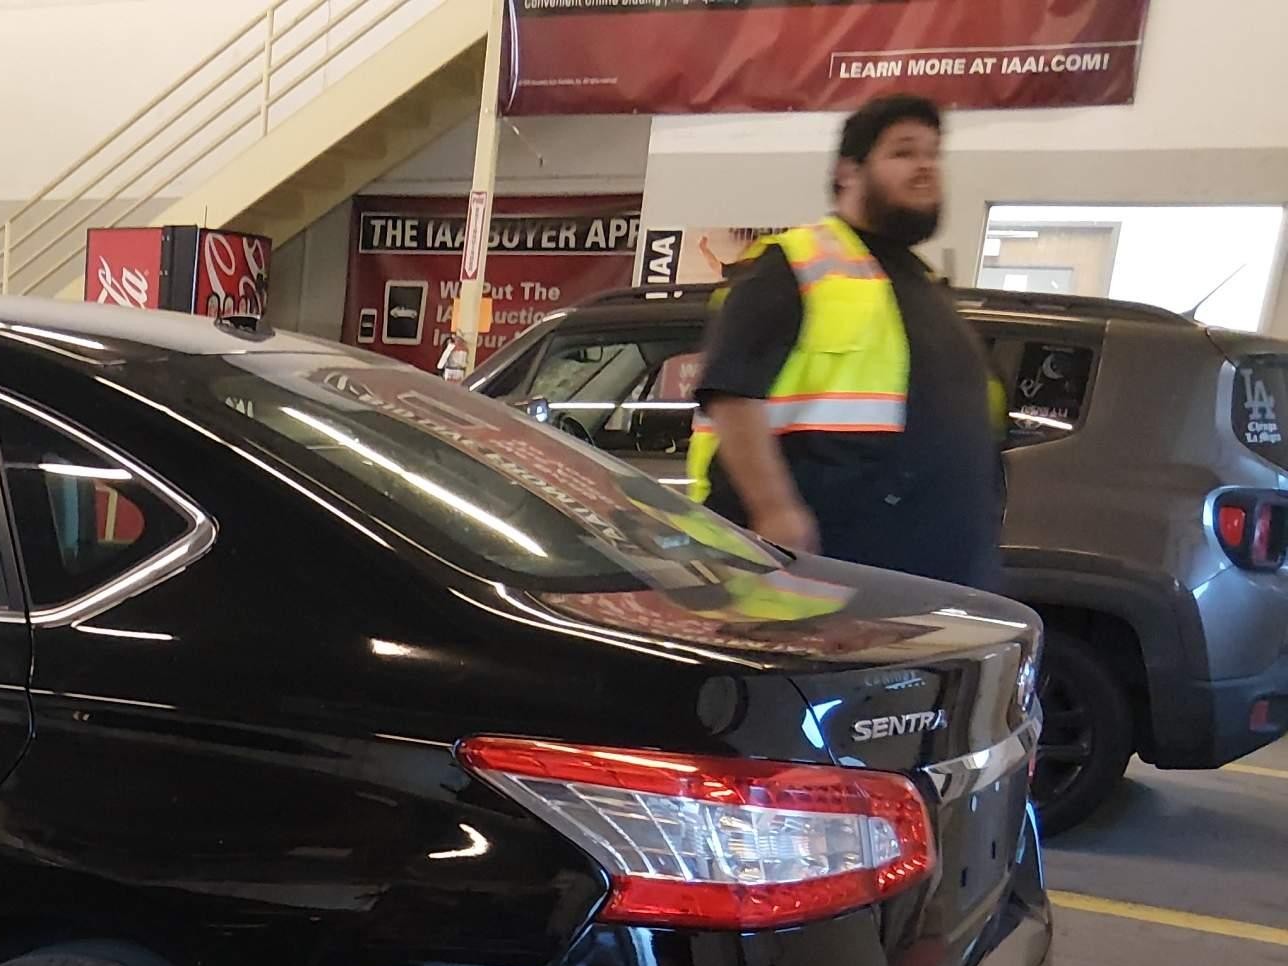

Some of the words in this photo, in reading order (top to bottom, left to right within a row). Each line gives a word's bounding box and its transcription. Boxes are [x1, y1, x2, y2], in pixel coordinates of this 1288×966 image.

[839, 60, 901, 78] LEARN
[907, 58, 966, 77] MORE
[969, 57, 997, 75] AT
[1001, 53, 1110, 74] IAAI.COM!
[370, 219, 418, 247] THE
[487, 221, 576, 249] BUYER
[440, 281, 462, 299] W
[520, 282, 561, 300] The
[851, 709, 947, 741] SENTRA
